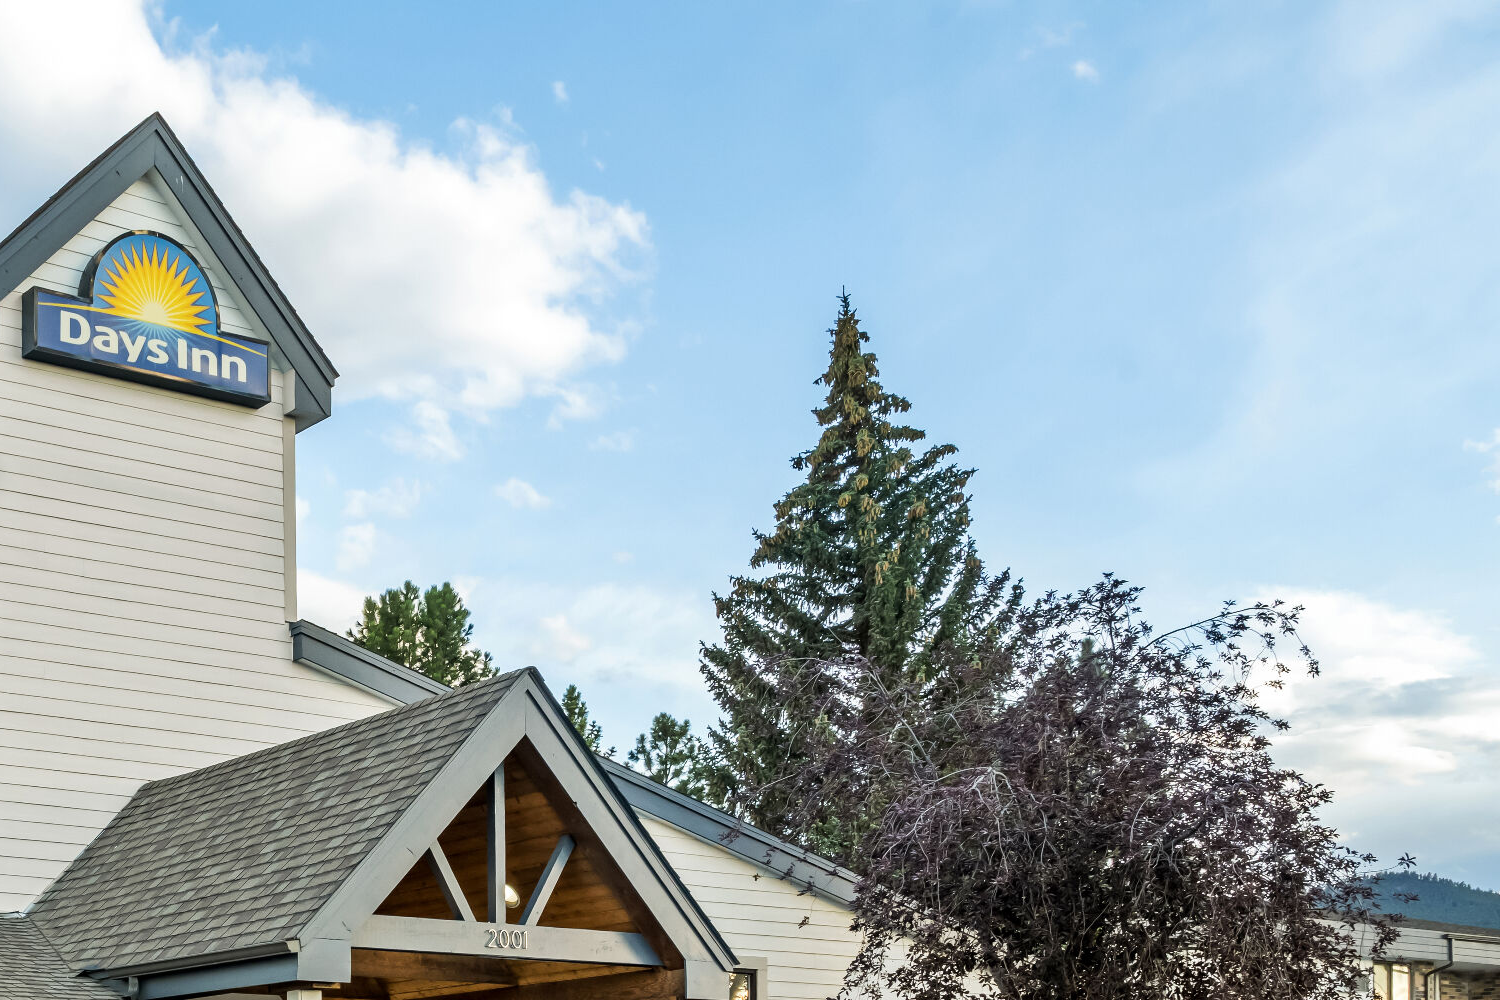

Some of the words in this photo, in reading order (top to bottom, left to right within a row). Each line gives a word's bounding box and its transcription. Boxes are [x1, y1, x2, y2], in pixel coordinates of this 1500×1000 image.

[59, 310, 169, 364] Days
[177, 338, 247, 382] Inn
[486, 928, 528, 950] 2001
